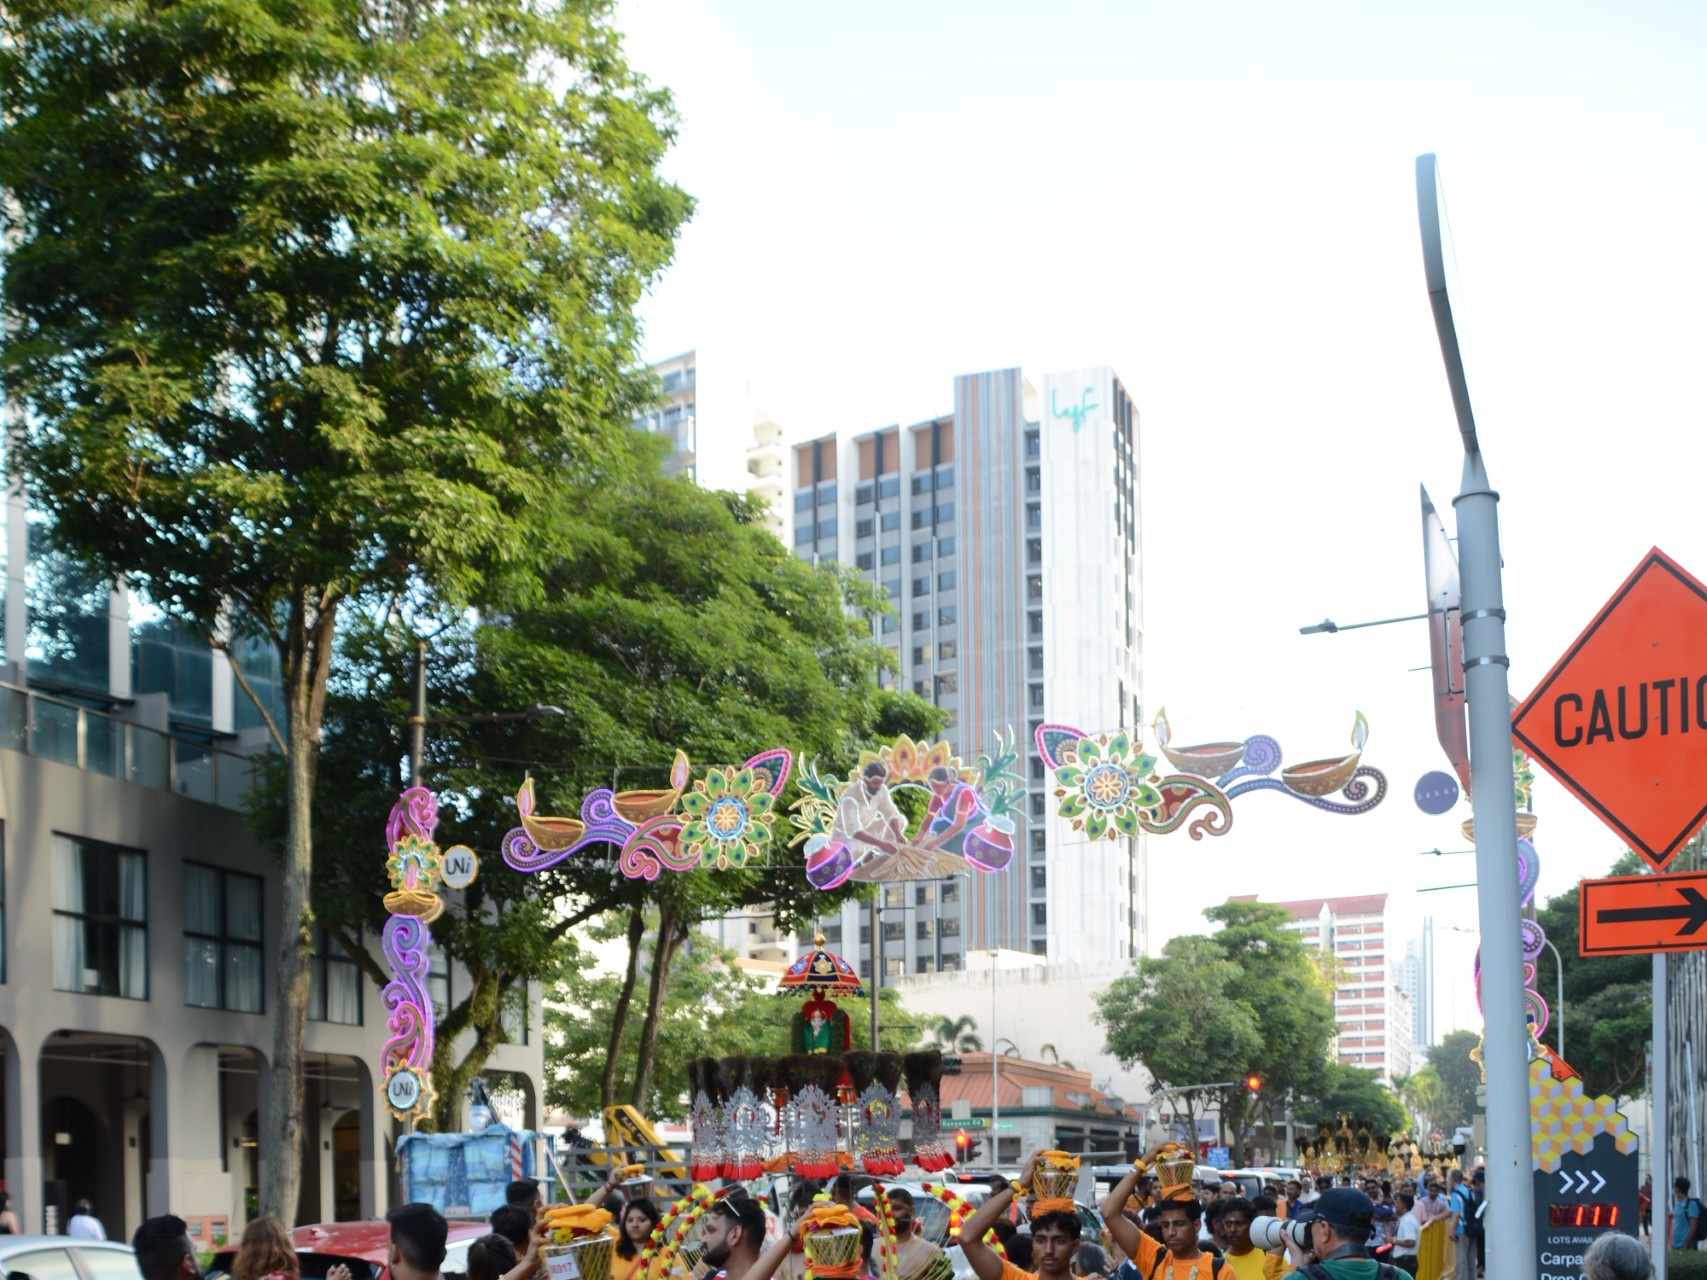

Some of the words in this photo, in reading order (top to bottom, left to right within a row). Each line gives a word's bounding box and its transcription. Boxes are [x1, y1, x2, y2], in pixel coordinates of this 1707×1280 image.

[1575, 1206, 1618, 1226] 111
[1547, 1236, 1571, 1245] LOTS
[1540, 1252, 1584, 1268] Carpa
